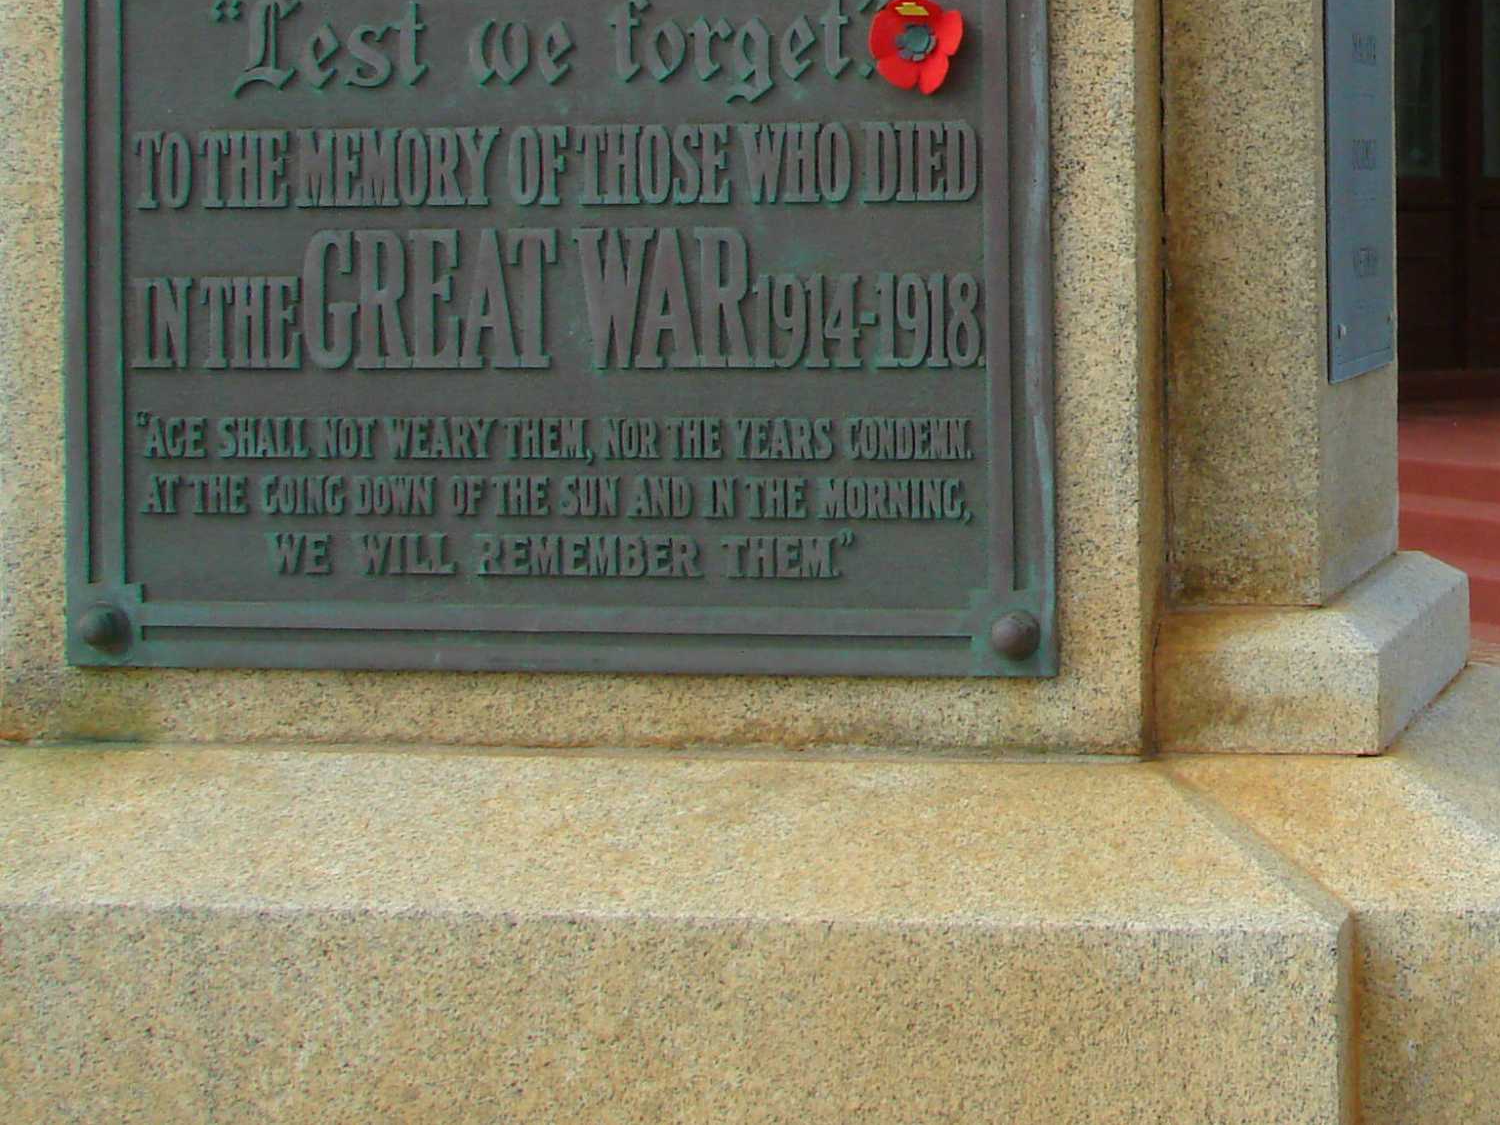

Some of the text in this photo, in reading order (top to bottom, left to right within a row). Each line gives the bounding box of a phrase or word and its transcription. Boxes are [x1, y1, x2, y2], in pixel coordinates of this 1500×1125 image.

[469, 19, 574, 86] we
[135, 120, 978, 210] TO THE MEMORY OF THOSE WHO DIED
[131, 277, 193, 369] IN
[201, 276, 300, 369] THE
[302, 228, 559, 369] GREAT
[573, 227, 757, 368] WAR
[219, 417, 310, 459] SHALL
[317, 417, 377, 459] NOT
[391, 417, 498, 459] WEARY
[504, 417, 594, 465] THEM,
[604, 418, 660, 459] NOR
[667, 418, 723, 459] THE
[734, 418, 834, 460] YEARS
[844, 418, 975, 460] CONDEMN.
[142, 475, 973, 525] AT THE GOING DOWN OF THE SUN AND IN THE MORNING,
[272, 532, 333, 575] WE
[358, 532, 457, 575] WILL
[475, 533, 701, 577] REMEMBER
